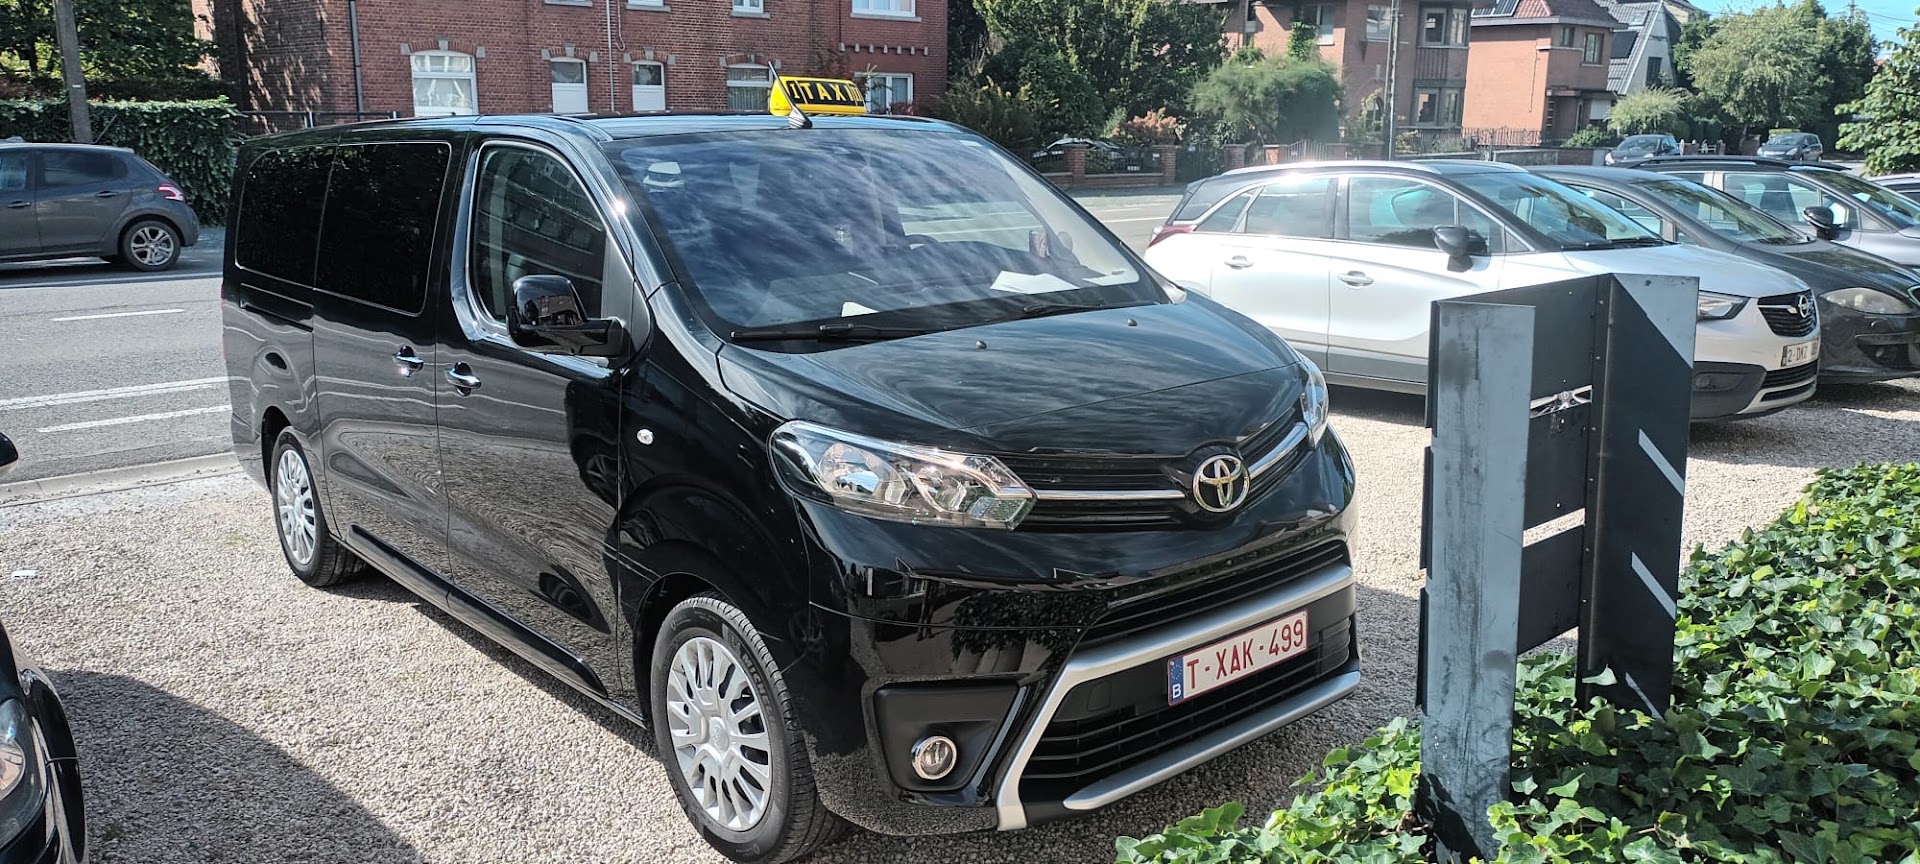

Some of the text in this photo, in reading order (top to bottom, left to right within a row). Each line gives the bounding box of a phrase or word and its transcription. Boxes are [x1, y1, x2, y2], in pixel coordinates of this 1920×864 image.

[801, 82, 854, 101] TAXI
[1186, 619, 1304, 690] T-XAK-499
[1172, 683, 1182, 699] B
